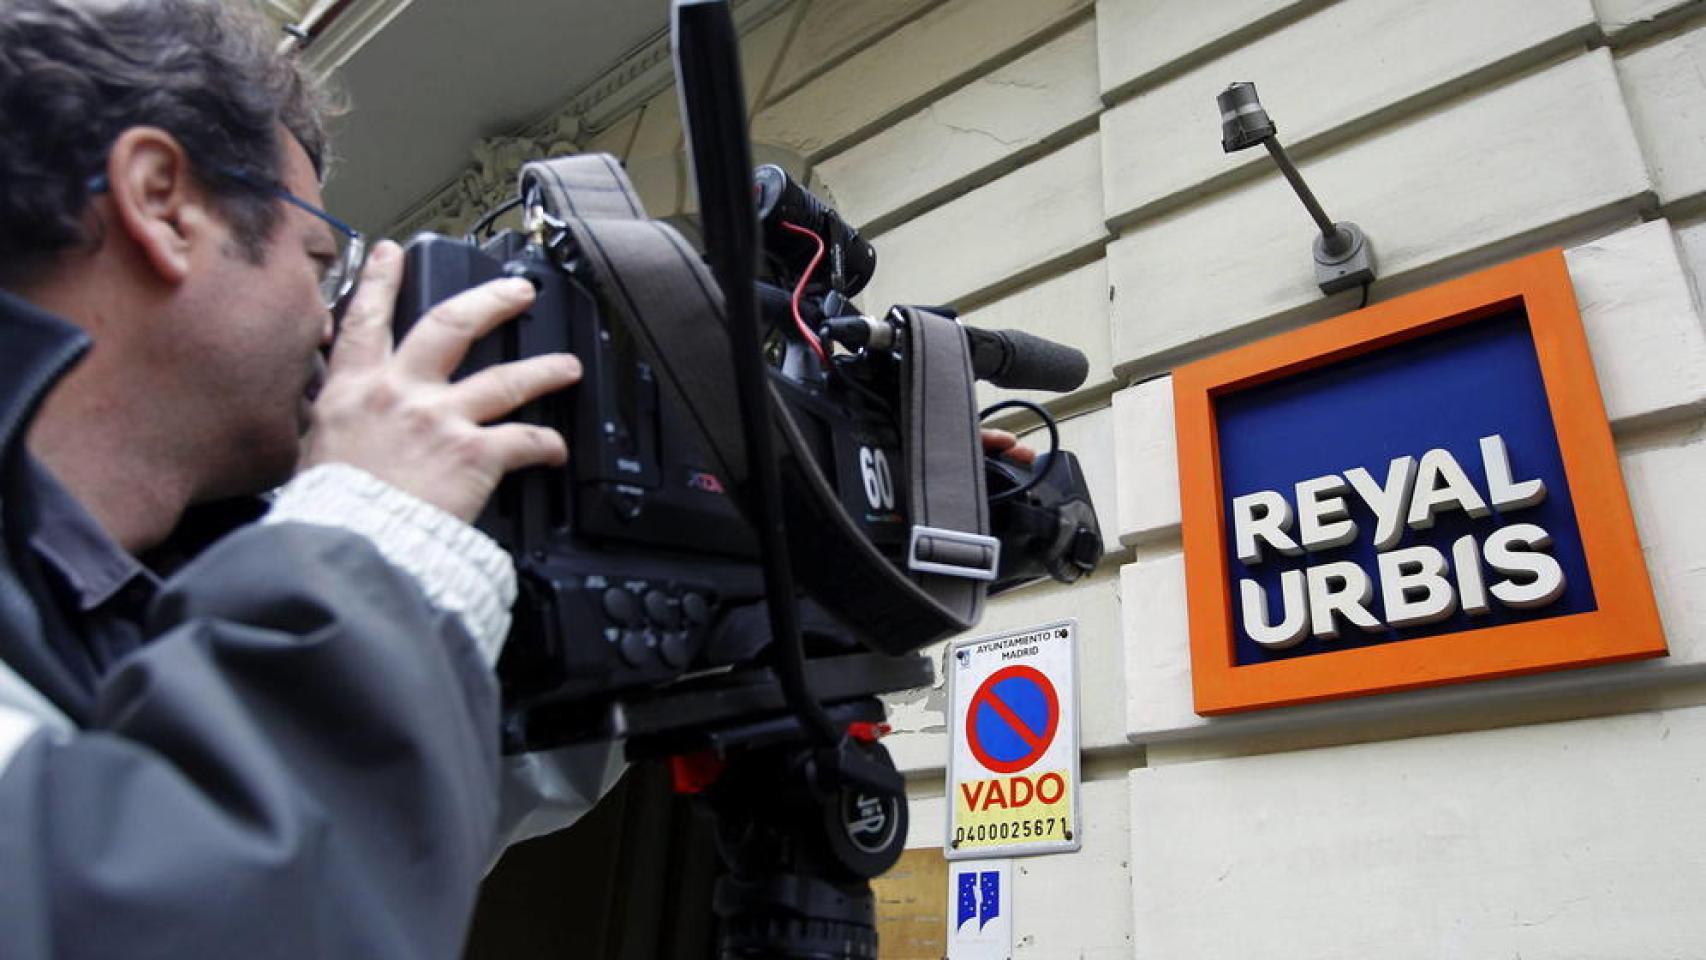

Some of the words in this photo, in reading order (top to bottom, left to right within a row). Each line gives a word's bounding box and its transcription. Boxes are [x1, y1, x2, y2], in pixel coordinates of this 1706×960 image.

[859, 445, 895, 511] 60
[1233, 434, 1546, 565] REYAL
[1240, 523, 1566, 649] URBIS
[976, 632, 1051, 654] AYUNTAMIENTO
[1055, 629, 1068, 640] D
[1001, 646, 1039, 660] MADRID
[960, 772, 1065, 812] VADO
[957, 817, 1067, 842] 0400025671
